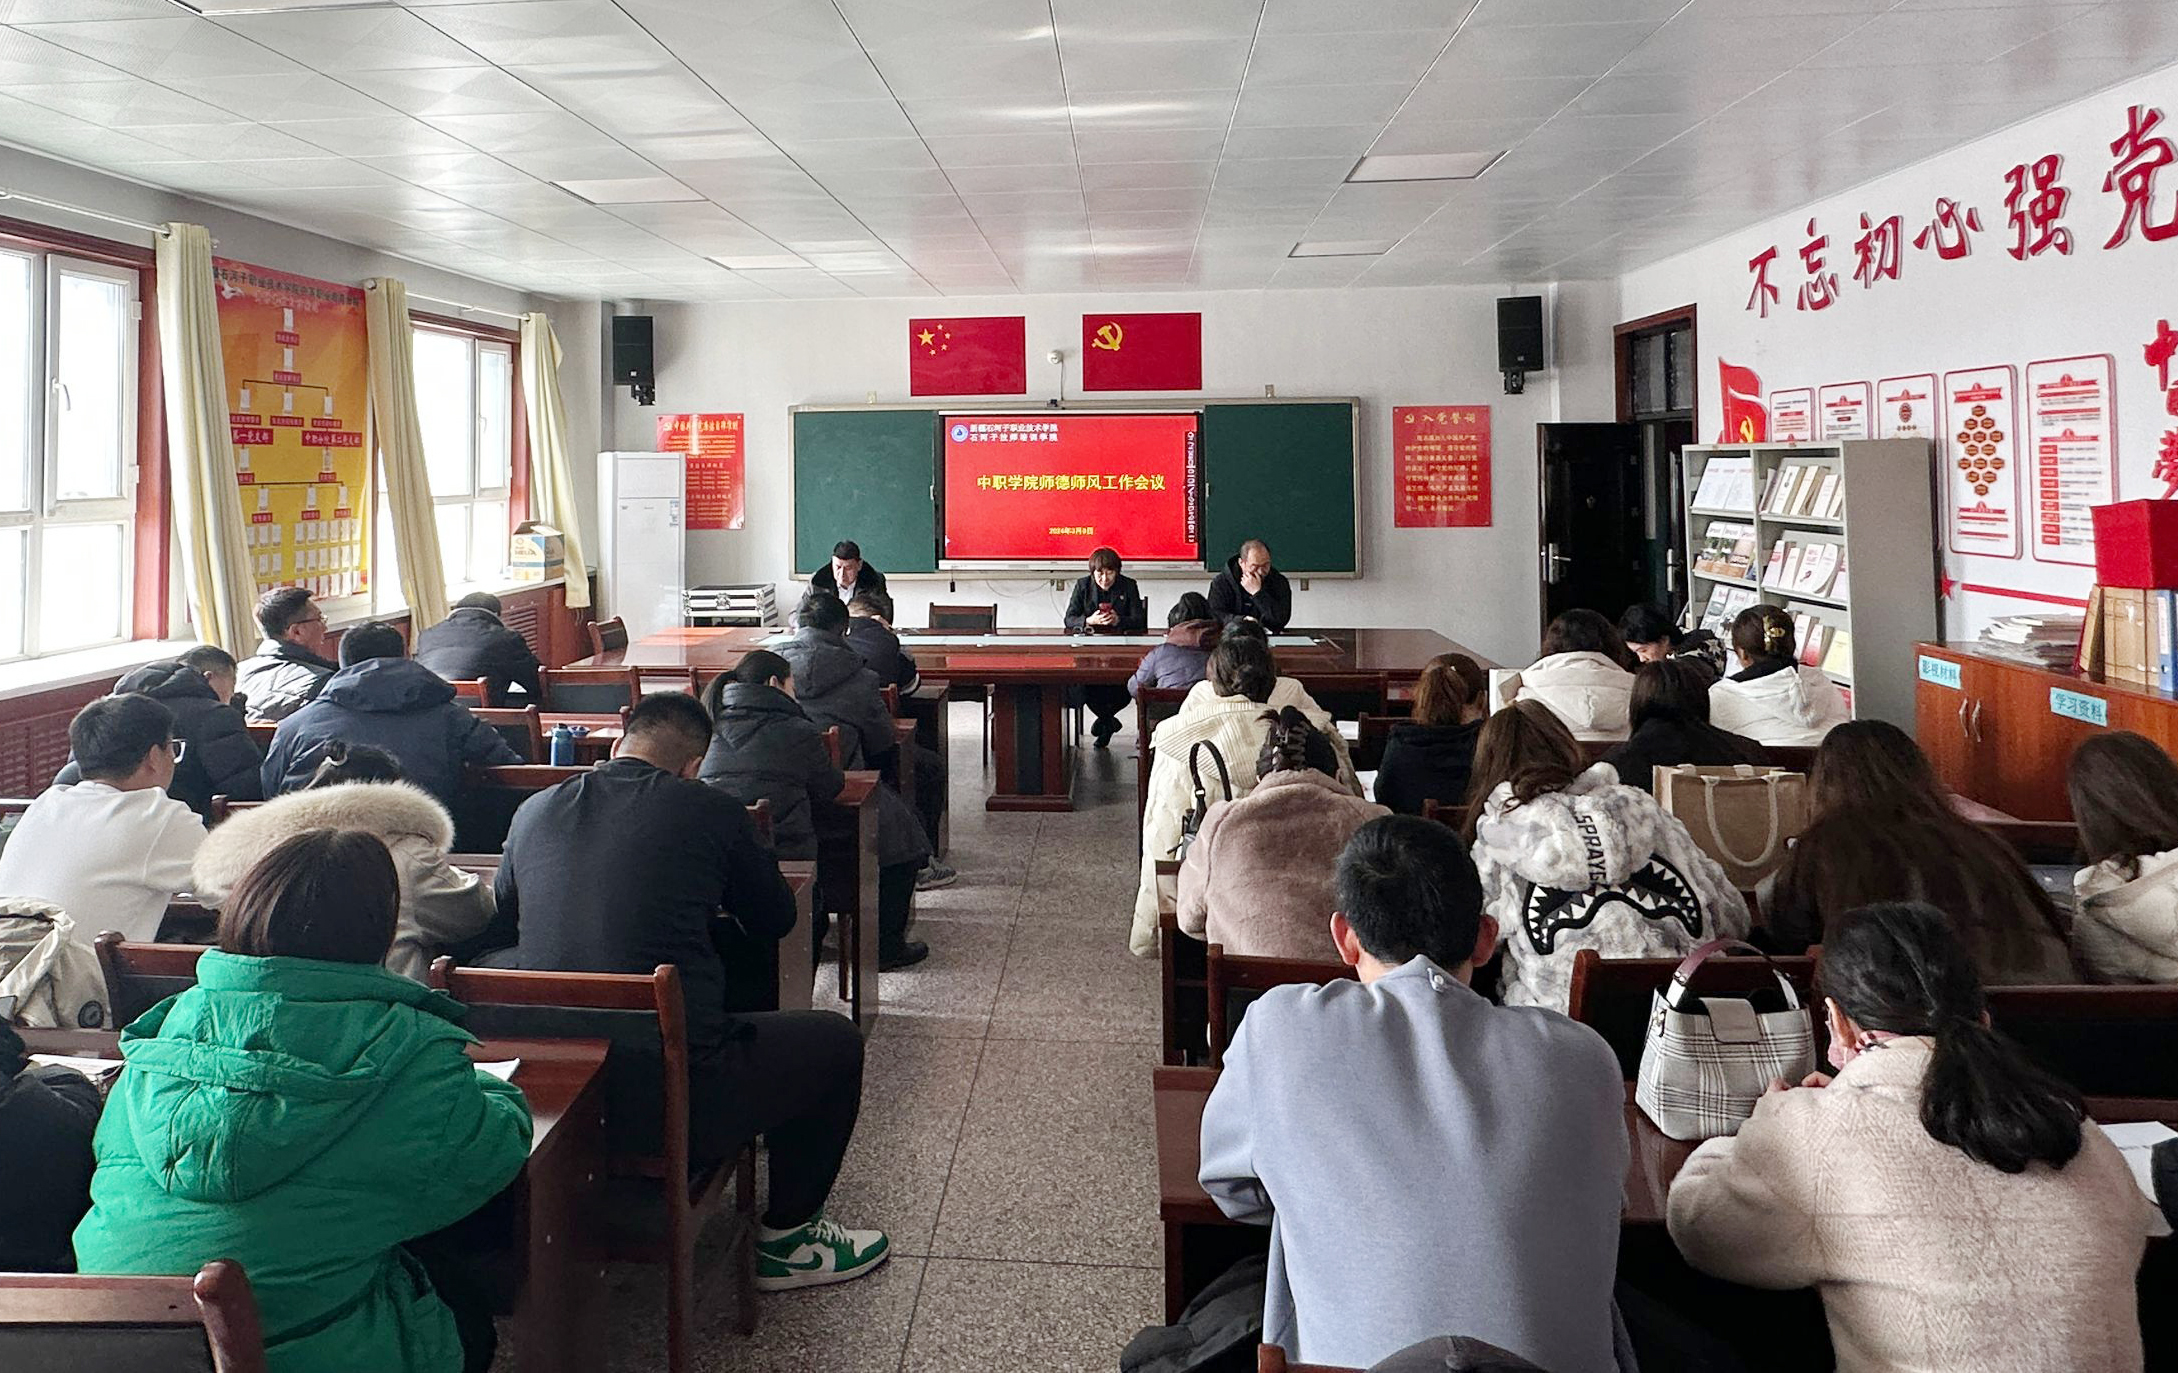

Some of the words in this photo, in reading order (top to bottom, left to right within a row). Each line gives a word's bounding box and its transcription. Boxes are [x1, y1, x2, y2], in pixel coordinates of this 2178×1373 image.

[1745, 104, 2178, 318] 不忘初心强党
[976, 474, 1166, 491] 中职学院师德师风工作会议
[2054, 692, 2103, 723] 学习资料
